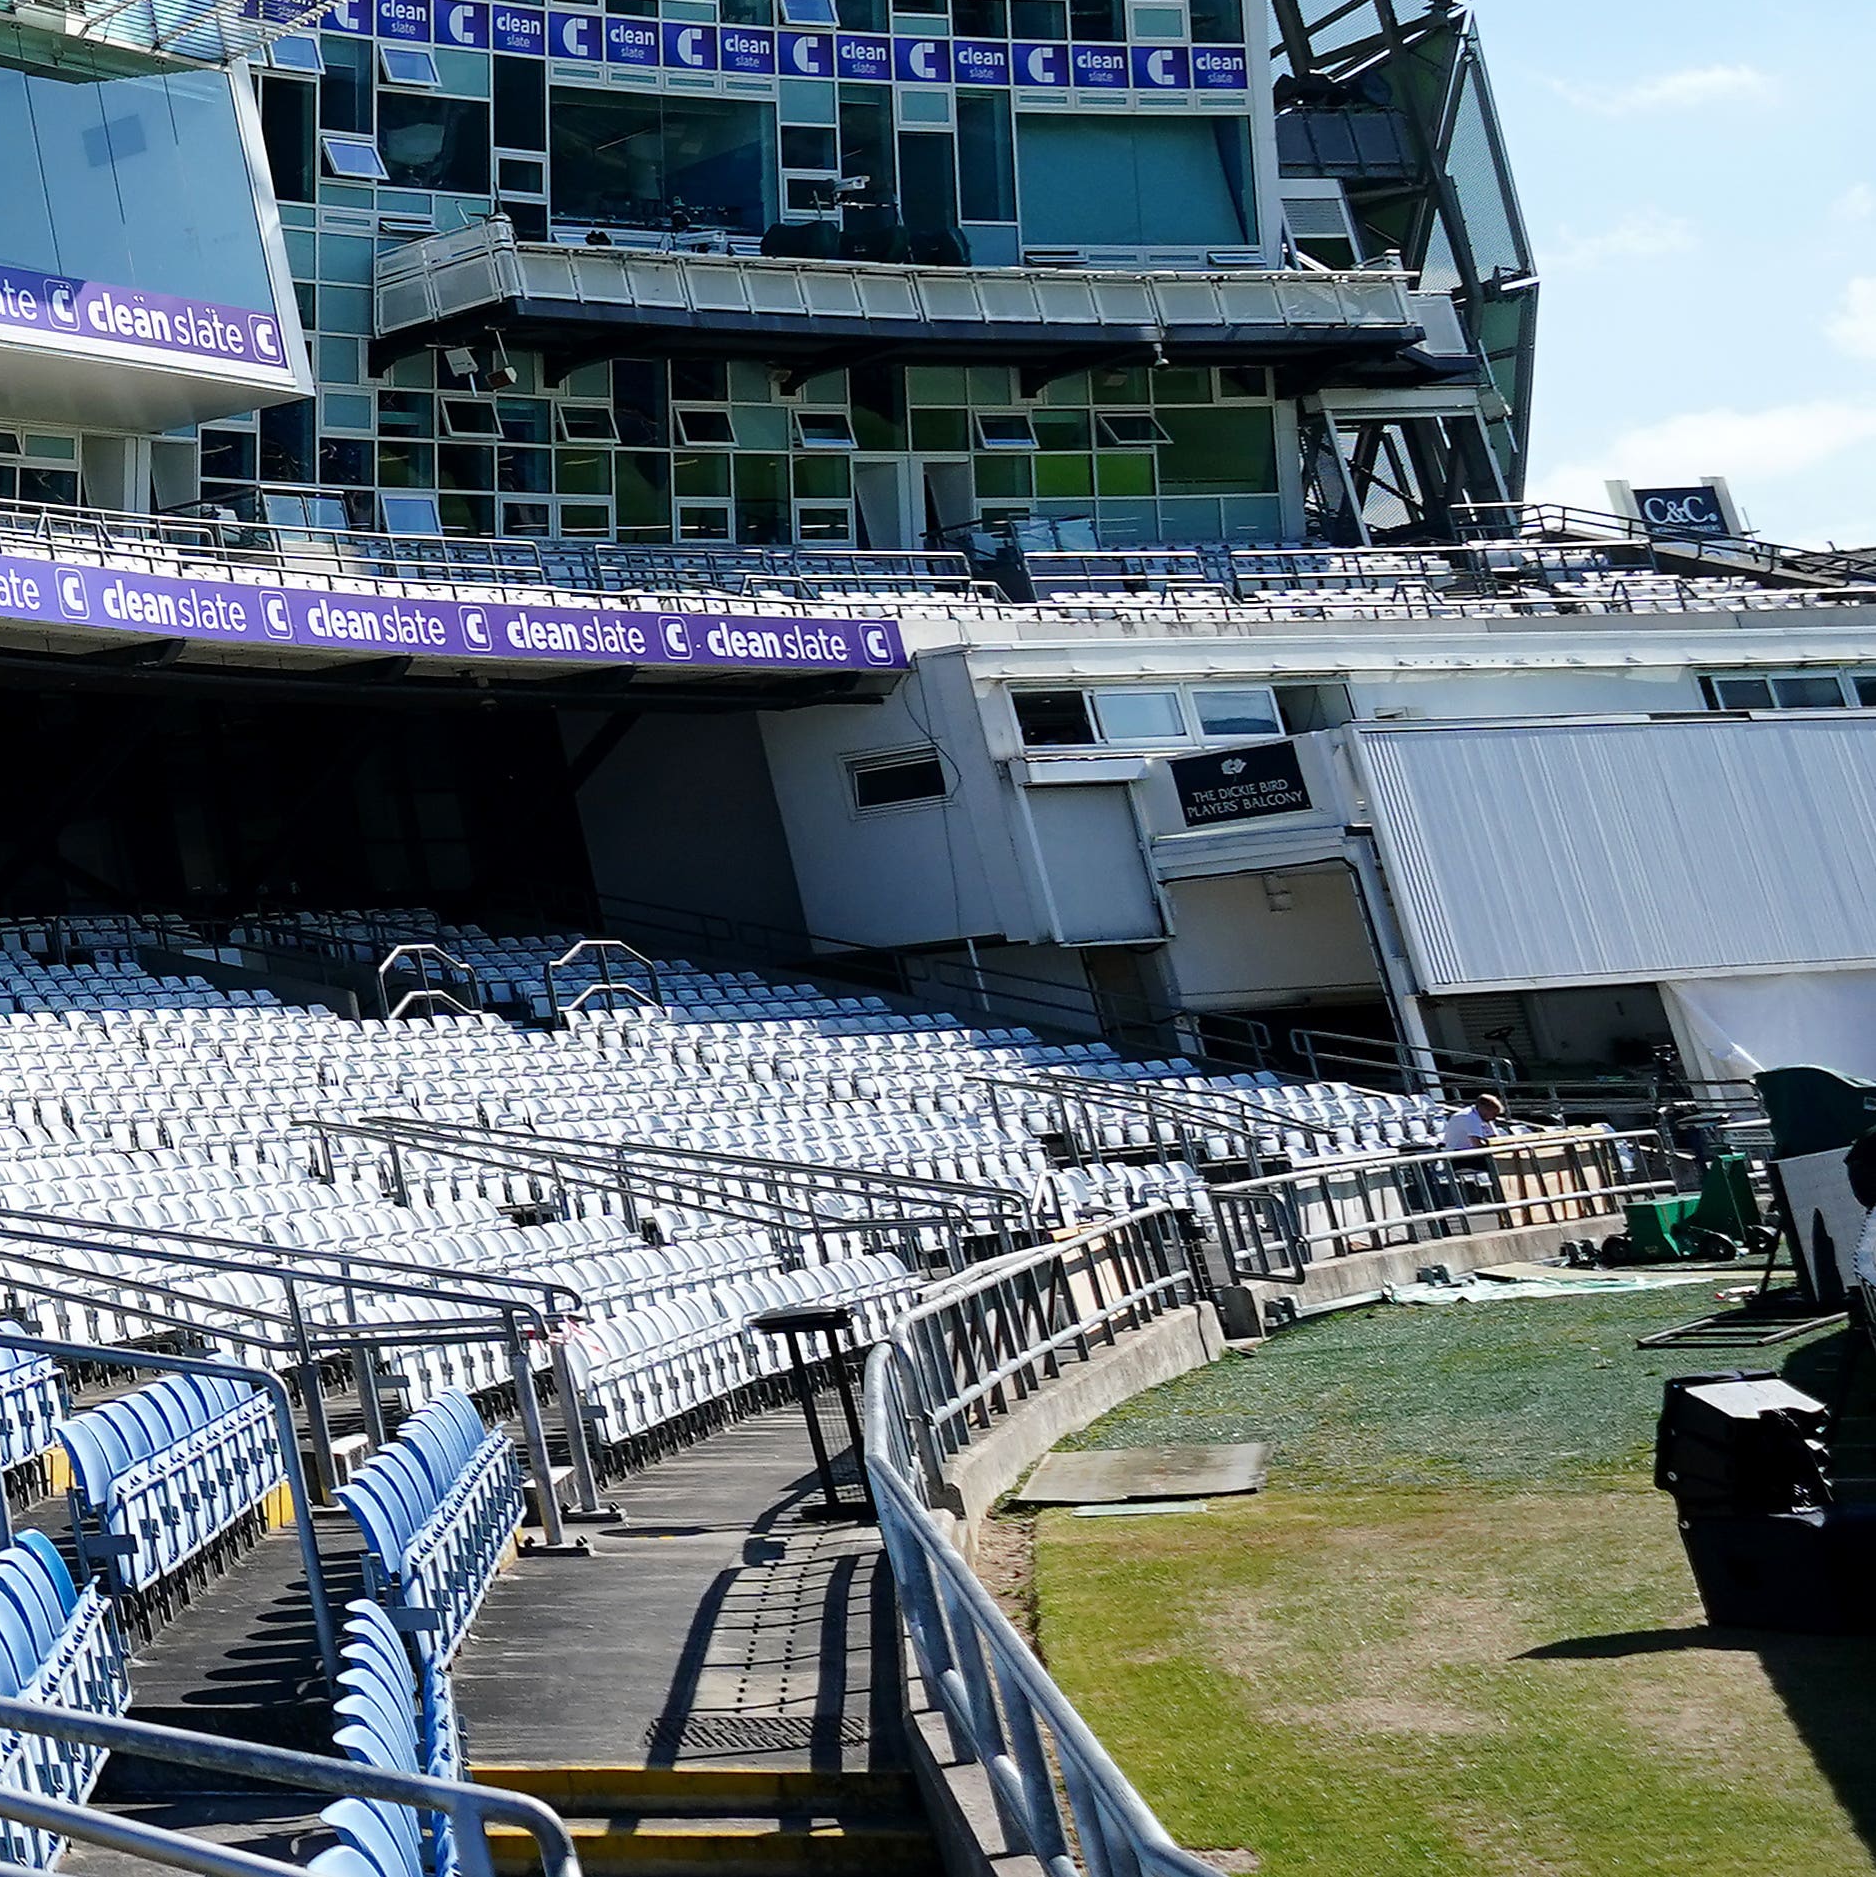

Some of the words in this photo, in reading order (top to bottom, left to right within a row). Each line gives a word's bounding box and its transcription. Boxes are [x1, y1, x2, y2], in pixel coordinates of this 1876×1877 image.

[496, 12, 541, 35] clean
[610, 24, 655, 46] clean
[724, 34, 770, 55] clean
[841, 41, 886, 61] clean
[958, 47, 1004, 66] clean
[1077, 51, 1123, 69] clean
[1196, 53, 1243, 70] clean
[52, 289, 75, 324] C
[87, 292, 173, 342] clean
[173, 306, 245, 354] slate
[255, 323, 278, 357] C
[62, 576, 85, 611] C
[102, 579, 178, 626] clean
[178, 588, 247, 632] slate
[266, 599, 288, 632] C
[307, 598, 382, 641] clean
[382, 605, 446, 645] slate
[466, 613, 487, 644] C
[506, 612, 582, 651] clean
[582, 616, 646, 654] slate
[666, 623, 687, 652] C
[707, 622, 783, 658] clean
[783, 625, 848, 661] slate
[867, 630, 888, 658] C
[1192, 790, 1217, 804] THE
[1218, 783, 1258, 799] DICKIE
[1259, 779, 1289, 794] BIRD
[1243, 790, 1304, 810] BALCONY
